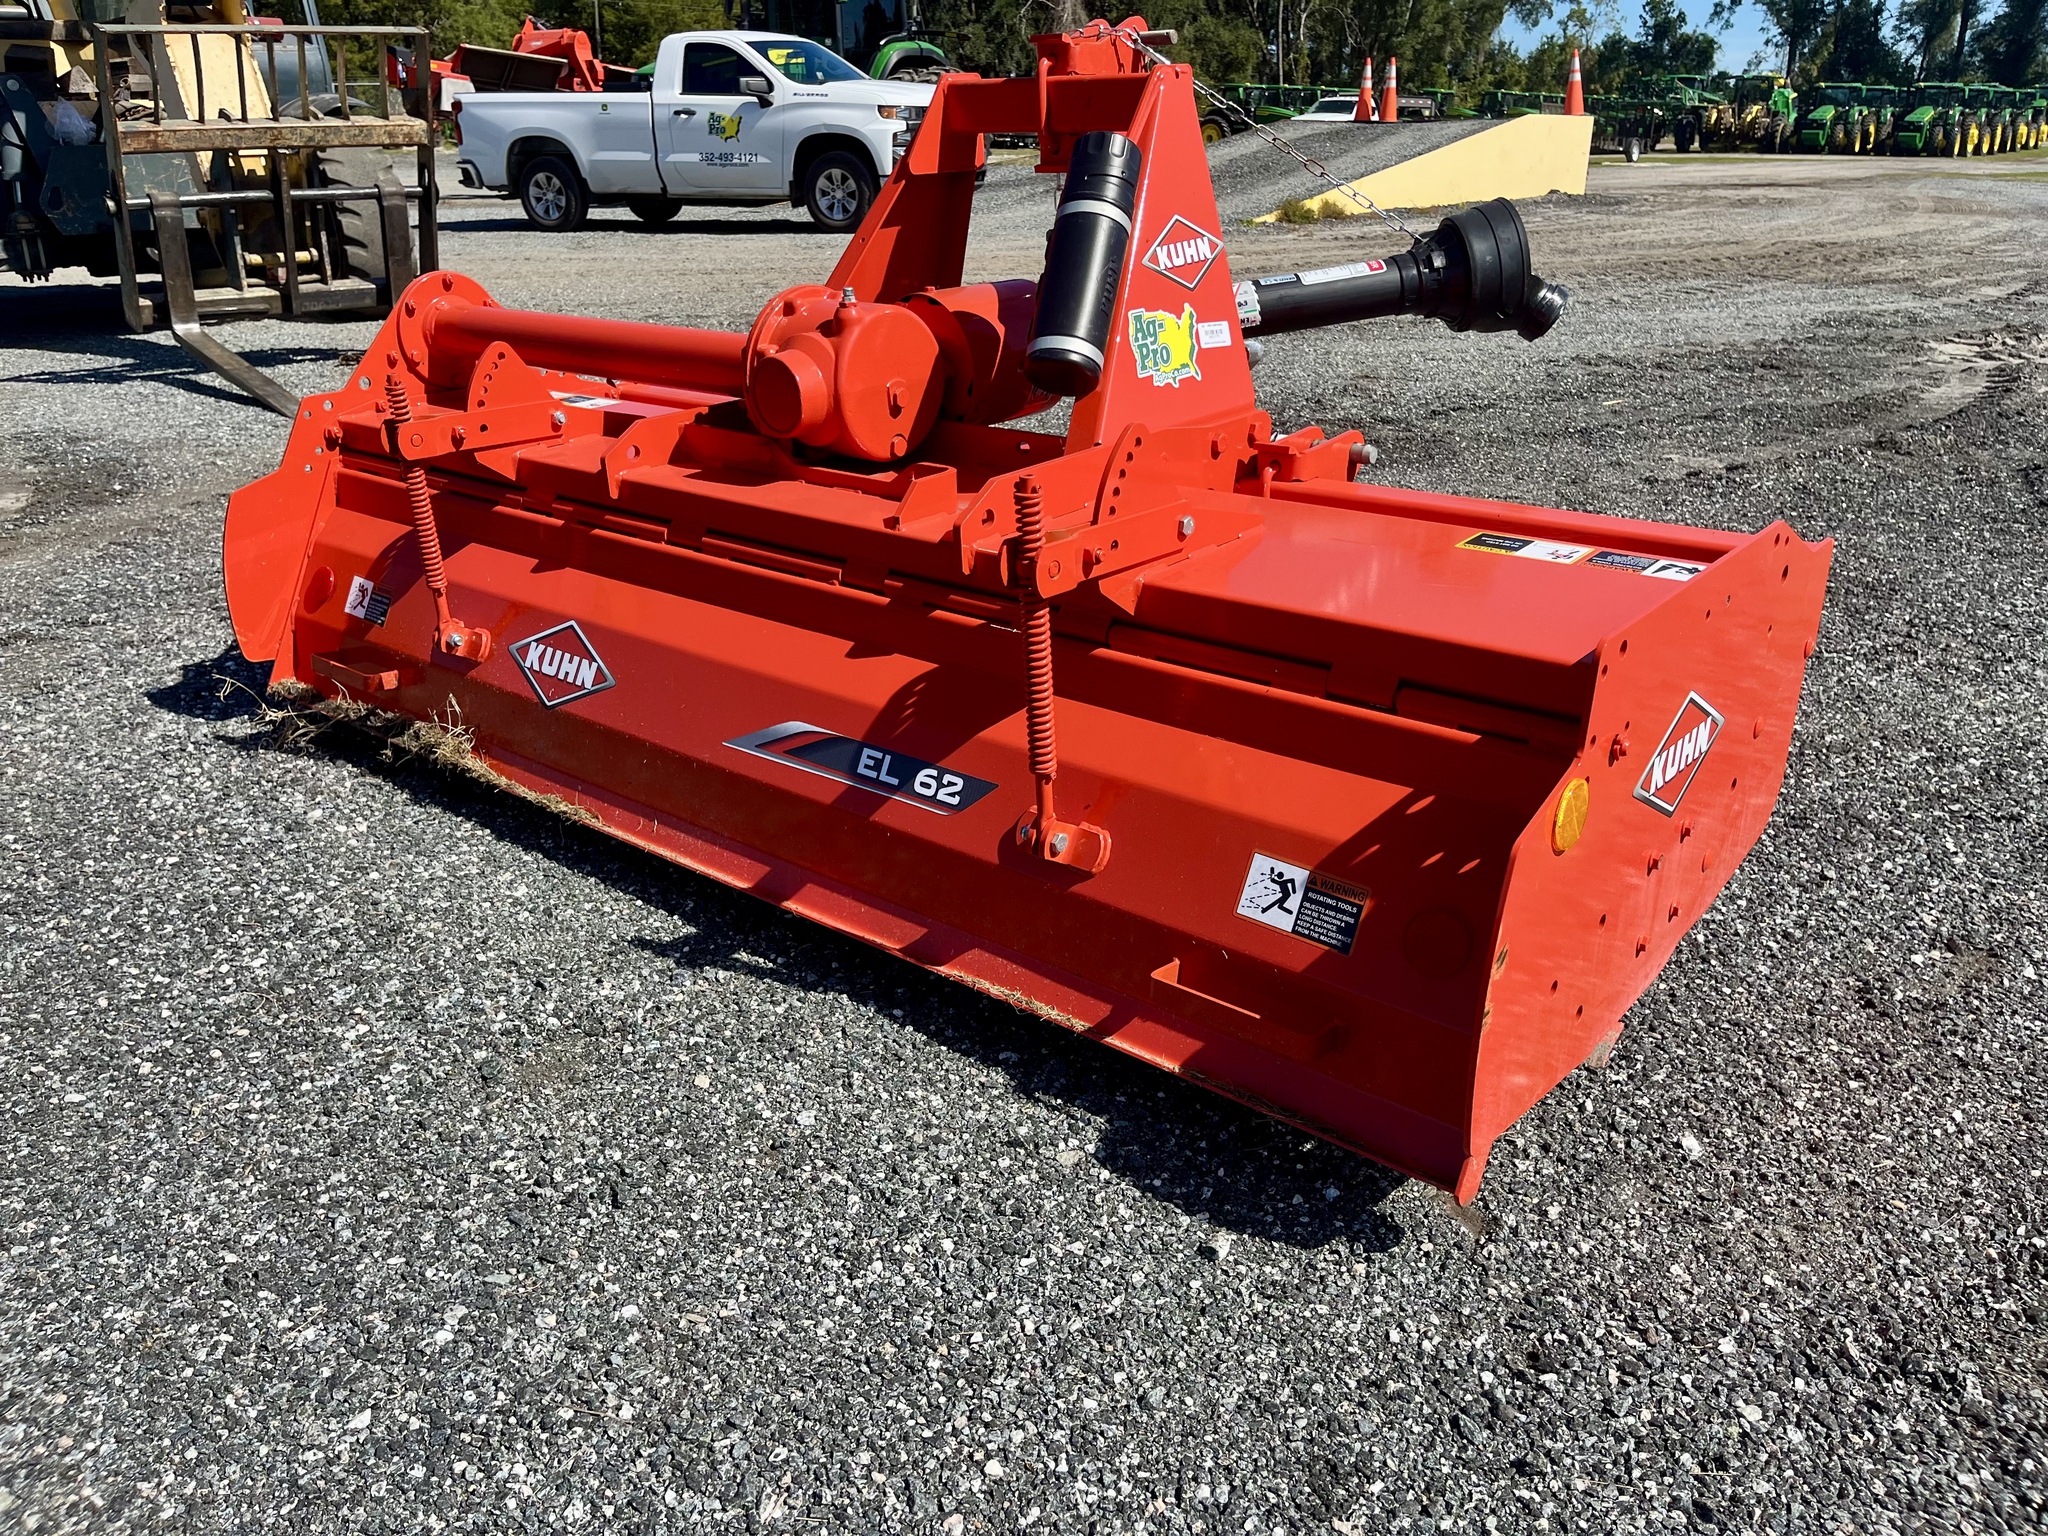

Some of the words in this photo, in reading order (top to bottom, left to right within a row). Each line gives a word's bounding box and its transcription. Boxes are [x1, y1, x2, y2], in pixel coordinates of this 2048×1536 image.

[708, 112, 725, 125] Ag-
[708, 124, 726, 134] Pro
[699, 152, 758, 162] 352-493-4121
[1156, 237, 1213, 270] KUHN
[1133, 314, 1164, 346] Ag-
[1137, 342, 1170, 372] Pro
[1154, 368, 1192, 384] AgProCo.com
[524, 642, 598, 690] KUHN
[1649, 716, 1712, 796] KUHN
[857, 747, 899, 786] EL
[913, 769, 964, 806] 62
[1320, 879, 1366, 902] WARNING
[1303, 902, 1325, 913] OBJECTS
[1325, 908, 1336, 917] AND
[1336, 912, 1354, 924] DEBRIS
[1308, 892, 1337, 906] ROTATING
[1338, 902, 1357, 913] TOOLS
[1299, 914, 1312, 922] LONG
[1301, 908, 1311, 916] CAN
[1320, 914, 1341, 925] THROWN
[1295, 926, 1309, 935] FROM
[1297, 920, 1310, 928] KEEP
[1315, 926, 1327, 935] SAFE
[1328, 930, 1352, 943] DISTANCE
